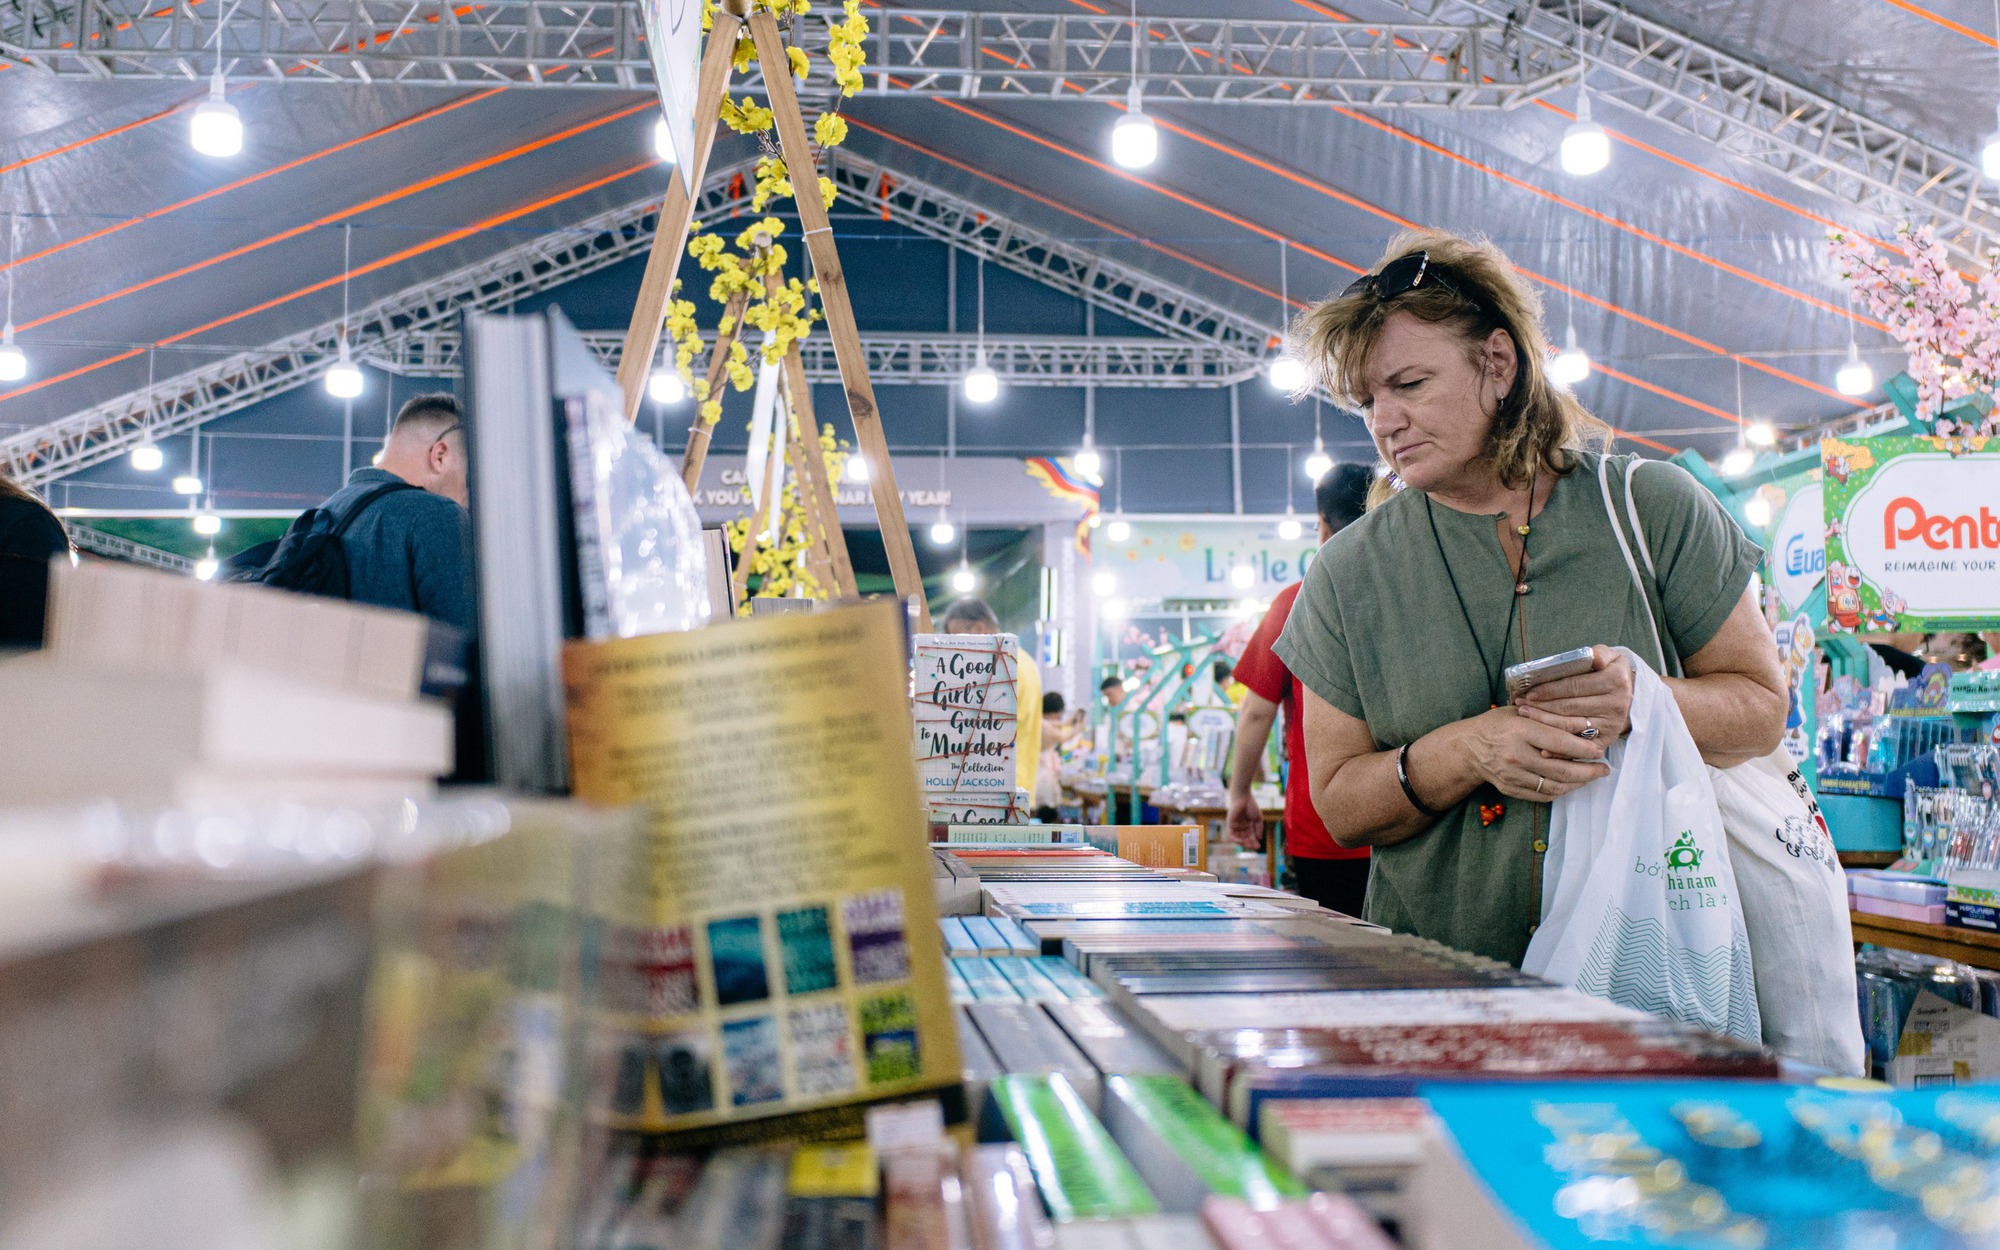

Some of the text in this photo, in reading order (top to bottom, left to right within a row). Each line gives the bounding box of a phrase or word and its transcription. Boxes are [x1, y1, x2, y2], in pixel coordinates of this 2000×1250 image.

[908, 490, 951, 506] YEAR!
[1884, 497, 2000, 550] Pent
[1885, 561, 1996, 572] REIMAGINE YOUR
[936, 653, 996, 679] A Good
[933, 681, 986, 711] Girl's
[950, 711, 1004, 734] Guide
[921, 727, 1007, 759] to Murder
[951, 761, 1005, 773] The Collection
[926, 778, 1005, 787] HOLLY JACKSON
[1667, 873, 1717, 890] hã nam
[1698, 893, 1719, 908] là
